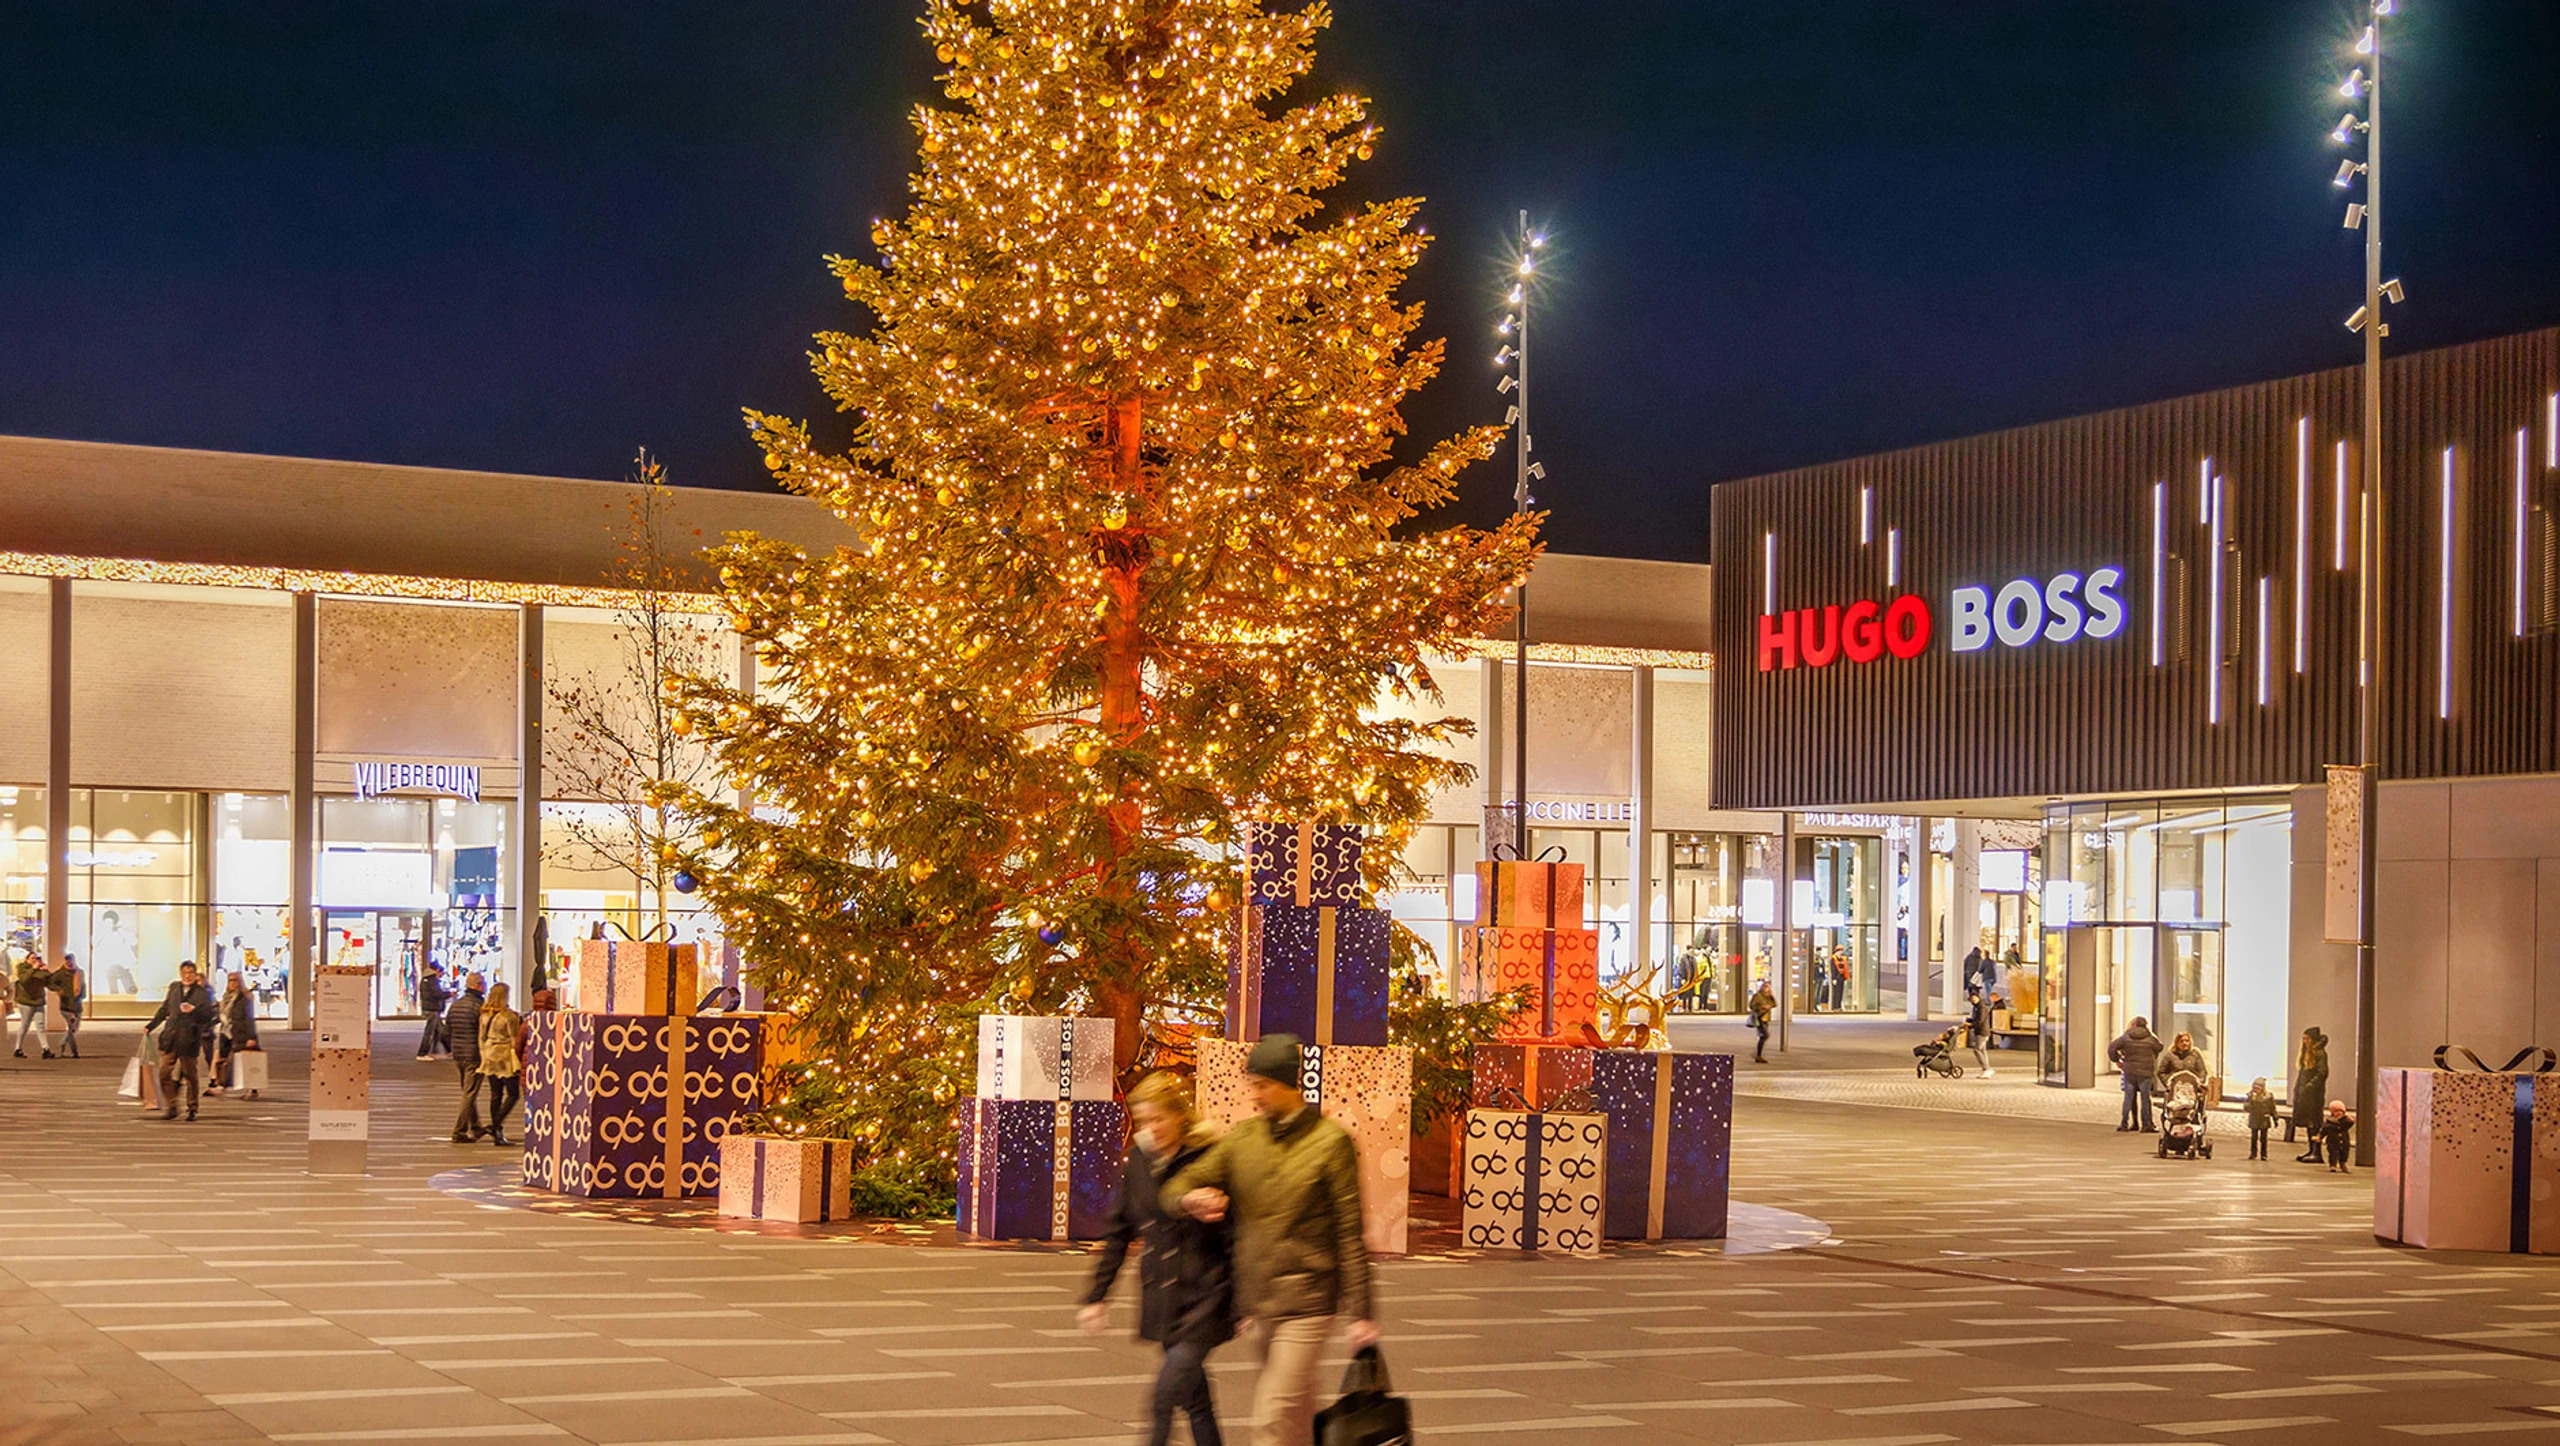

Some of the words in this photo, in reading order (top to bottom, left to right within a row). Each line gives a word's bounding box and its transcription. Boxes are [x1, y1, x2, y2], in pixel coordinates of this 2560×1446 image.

[1759, 594, 1931, 673] HUGO
[1952, 568, 2124, 652] BOSS
[355, 762, 480, 804] VILEBREQUIN
[1060, 1059, 1071, 1097] BOSS
[1302, 1045, 1321, 1104] BOSS
[1055, 1136, 1068, 1181] BOSS
[1053, 1191, 1067, 1237] BOSS
